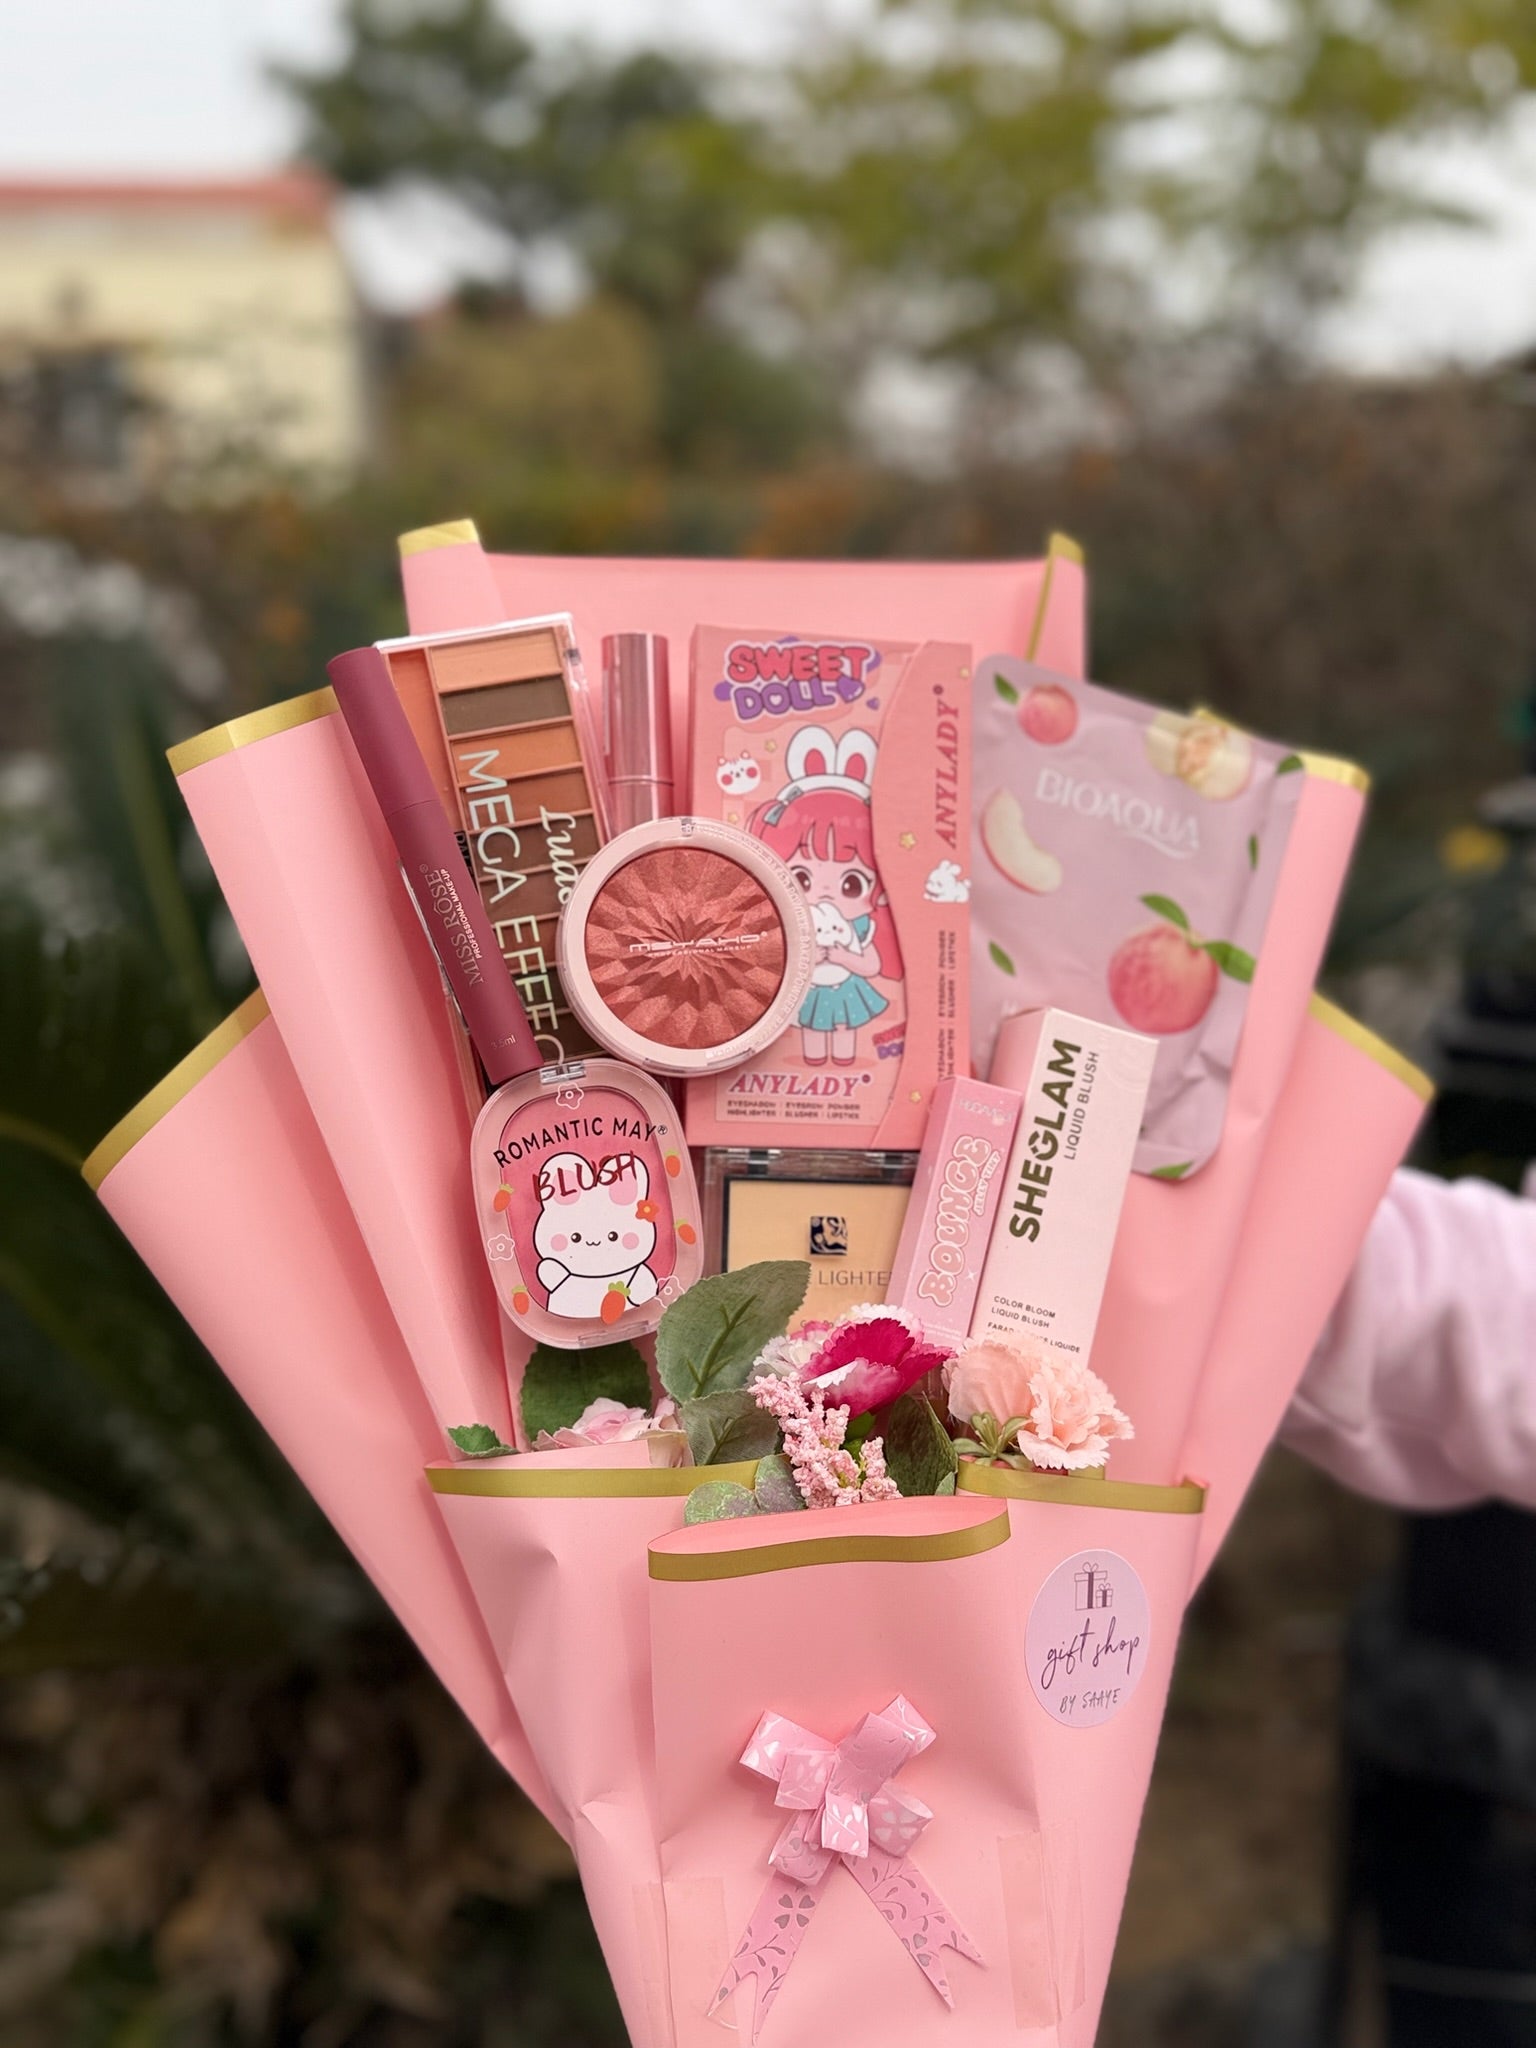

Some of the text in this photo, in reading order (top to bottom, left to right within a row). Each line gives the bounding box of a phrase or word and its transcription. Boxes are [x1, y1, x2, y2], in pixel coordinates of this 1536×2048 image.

[727, 644, 871, 683] SWEET
[733, 675, 836, 720] DOLL
[458, 749, 528, 904] MEGA
[1034, 767, 1201, 857] BIOAQUA
[452, 902, 482, 959] PROFESSIONAL
[451, 932, 484, 987] MISS
[729, 1073, 859, 1097] ANYLADY
[1063, 1051, 1100, 1161] LIQUID BLUSH
[493, 1116, 603, 1168] ROMANTIC
[1008, 1038, 1083, 1242] SHEGLAM
[532, 1150, 637, 1202] BLUSH
[918, 1135, 993, 1307] BOUNCE
[818, 1270, 893, 1287] LIGHTE
[991, 1306, 1050, 1329] LIQUID BLUSH
[993, 1294, 1057, 1319] COLOR BLOOM
[1049, 1340, 1080, 1353] LIQUIDE
[1041, 1615, 1140, 1690] gift shop
[1059, 1693, 1077, 1715] BY
